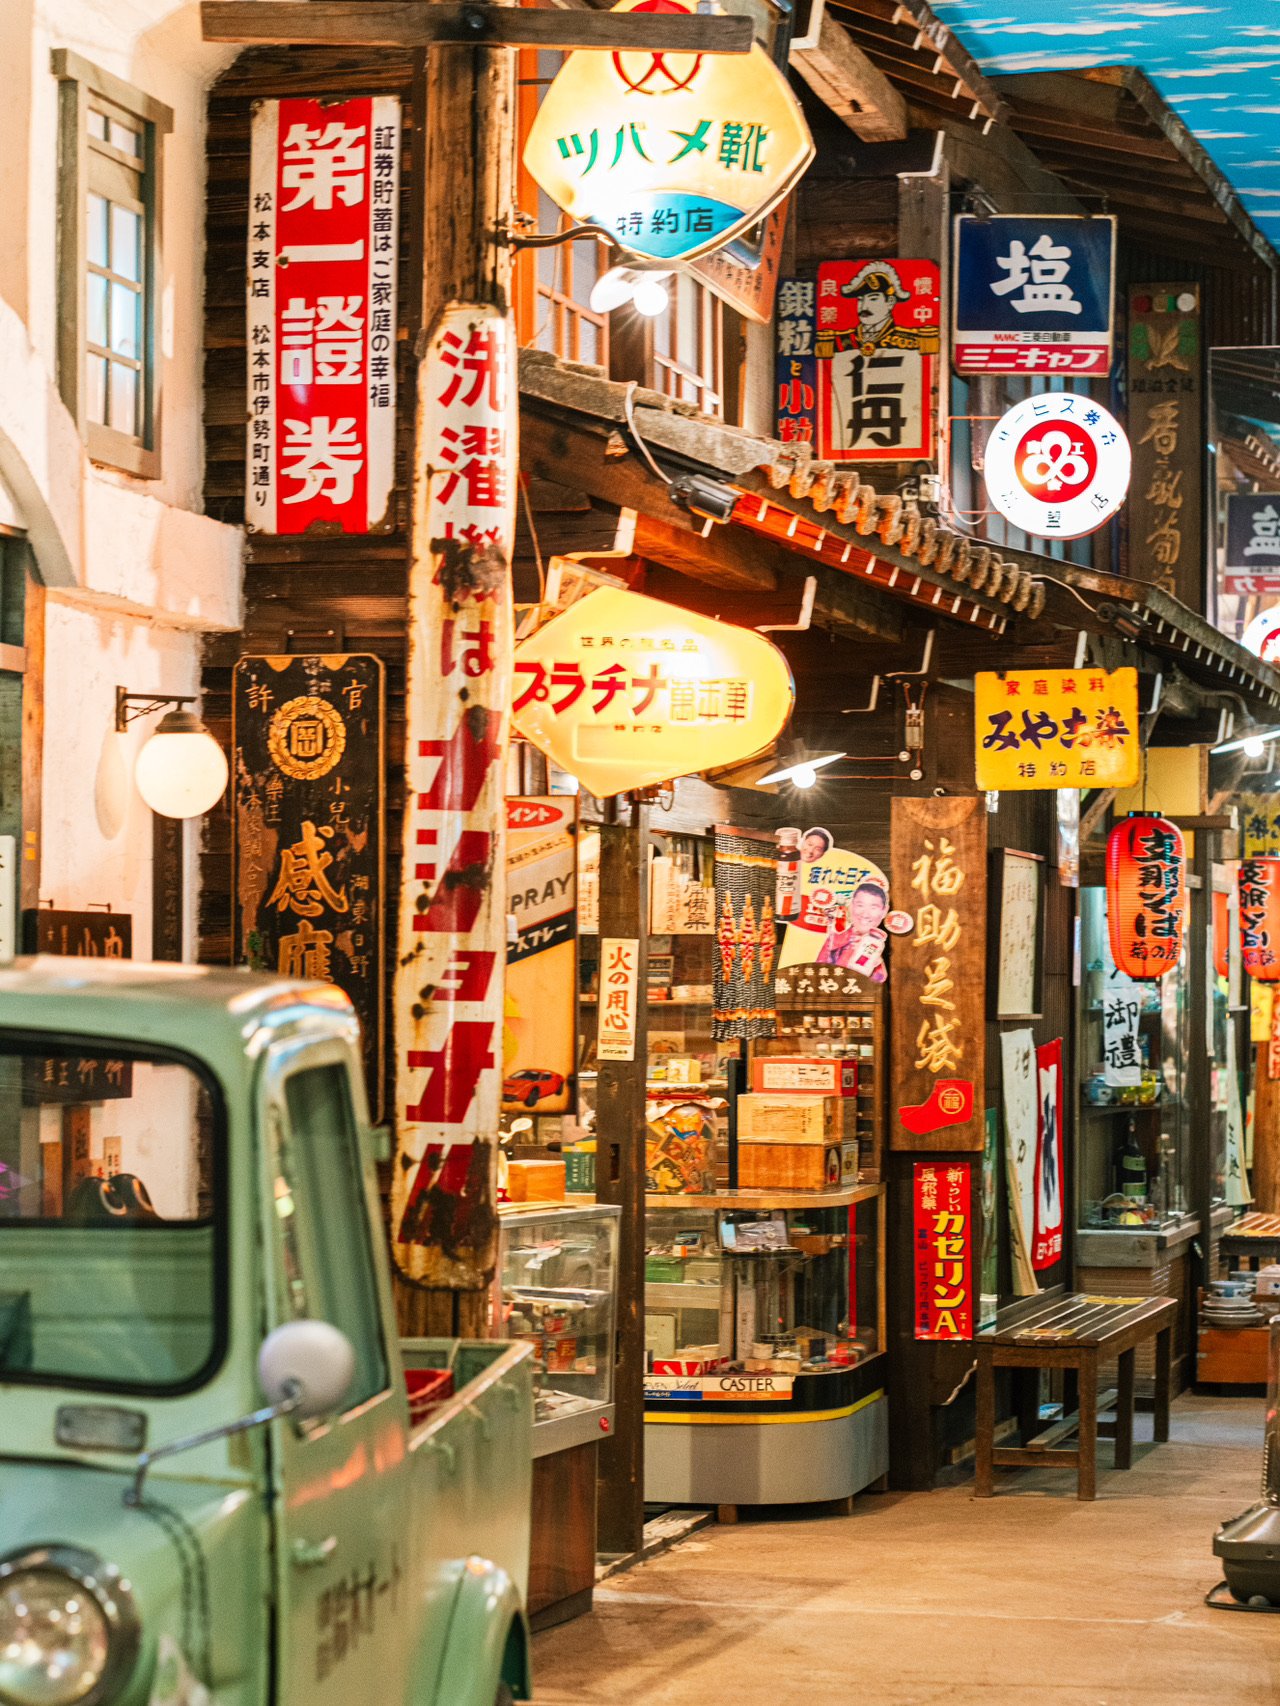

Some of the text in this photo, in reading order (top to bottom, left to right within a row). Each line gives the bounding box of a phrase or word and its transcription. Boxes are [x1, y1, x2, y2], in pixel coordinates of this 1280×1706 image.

[556, 118, 768, 177] ツバメ靴
[616, 207, 714, 237] 特約店
[368, 125, 397, 409] 証券貯蓄はご家庭の幸福
[989, 234, 1083, 315] 塩
[250, 192, 273, 508] 松本支店 松本市伊勢町通り
[280, 121, 366, 505] 第一證券
[844, 355, 907, 448] 仁丹
[1006, 678, 1105, 696] 家庭染料
[1018, 760, 1096, 778] 特約店
[604, 946, 632, 1031] 火の用心
[910, 837, 965, 1073] 福助足袋
[946, 1167, 965, 1212] 新らしい
[932, 1210, 967, 1334] カゼリンA
[719, 1377, 776, 1392] CASTER
